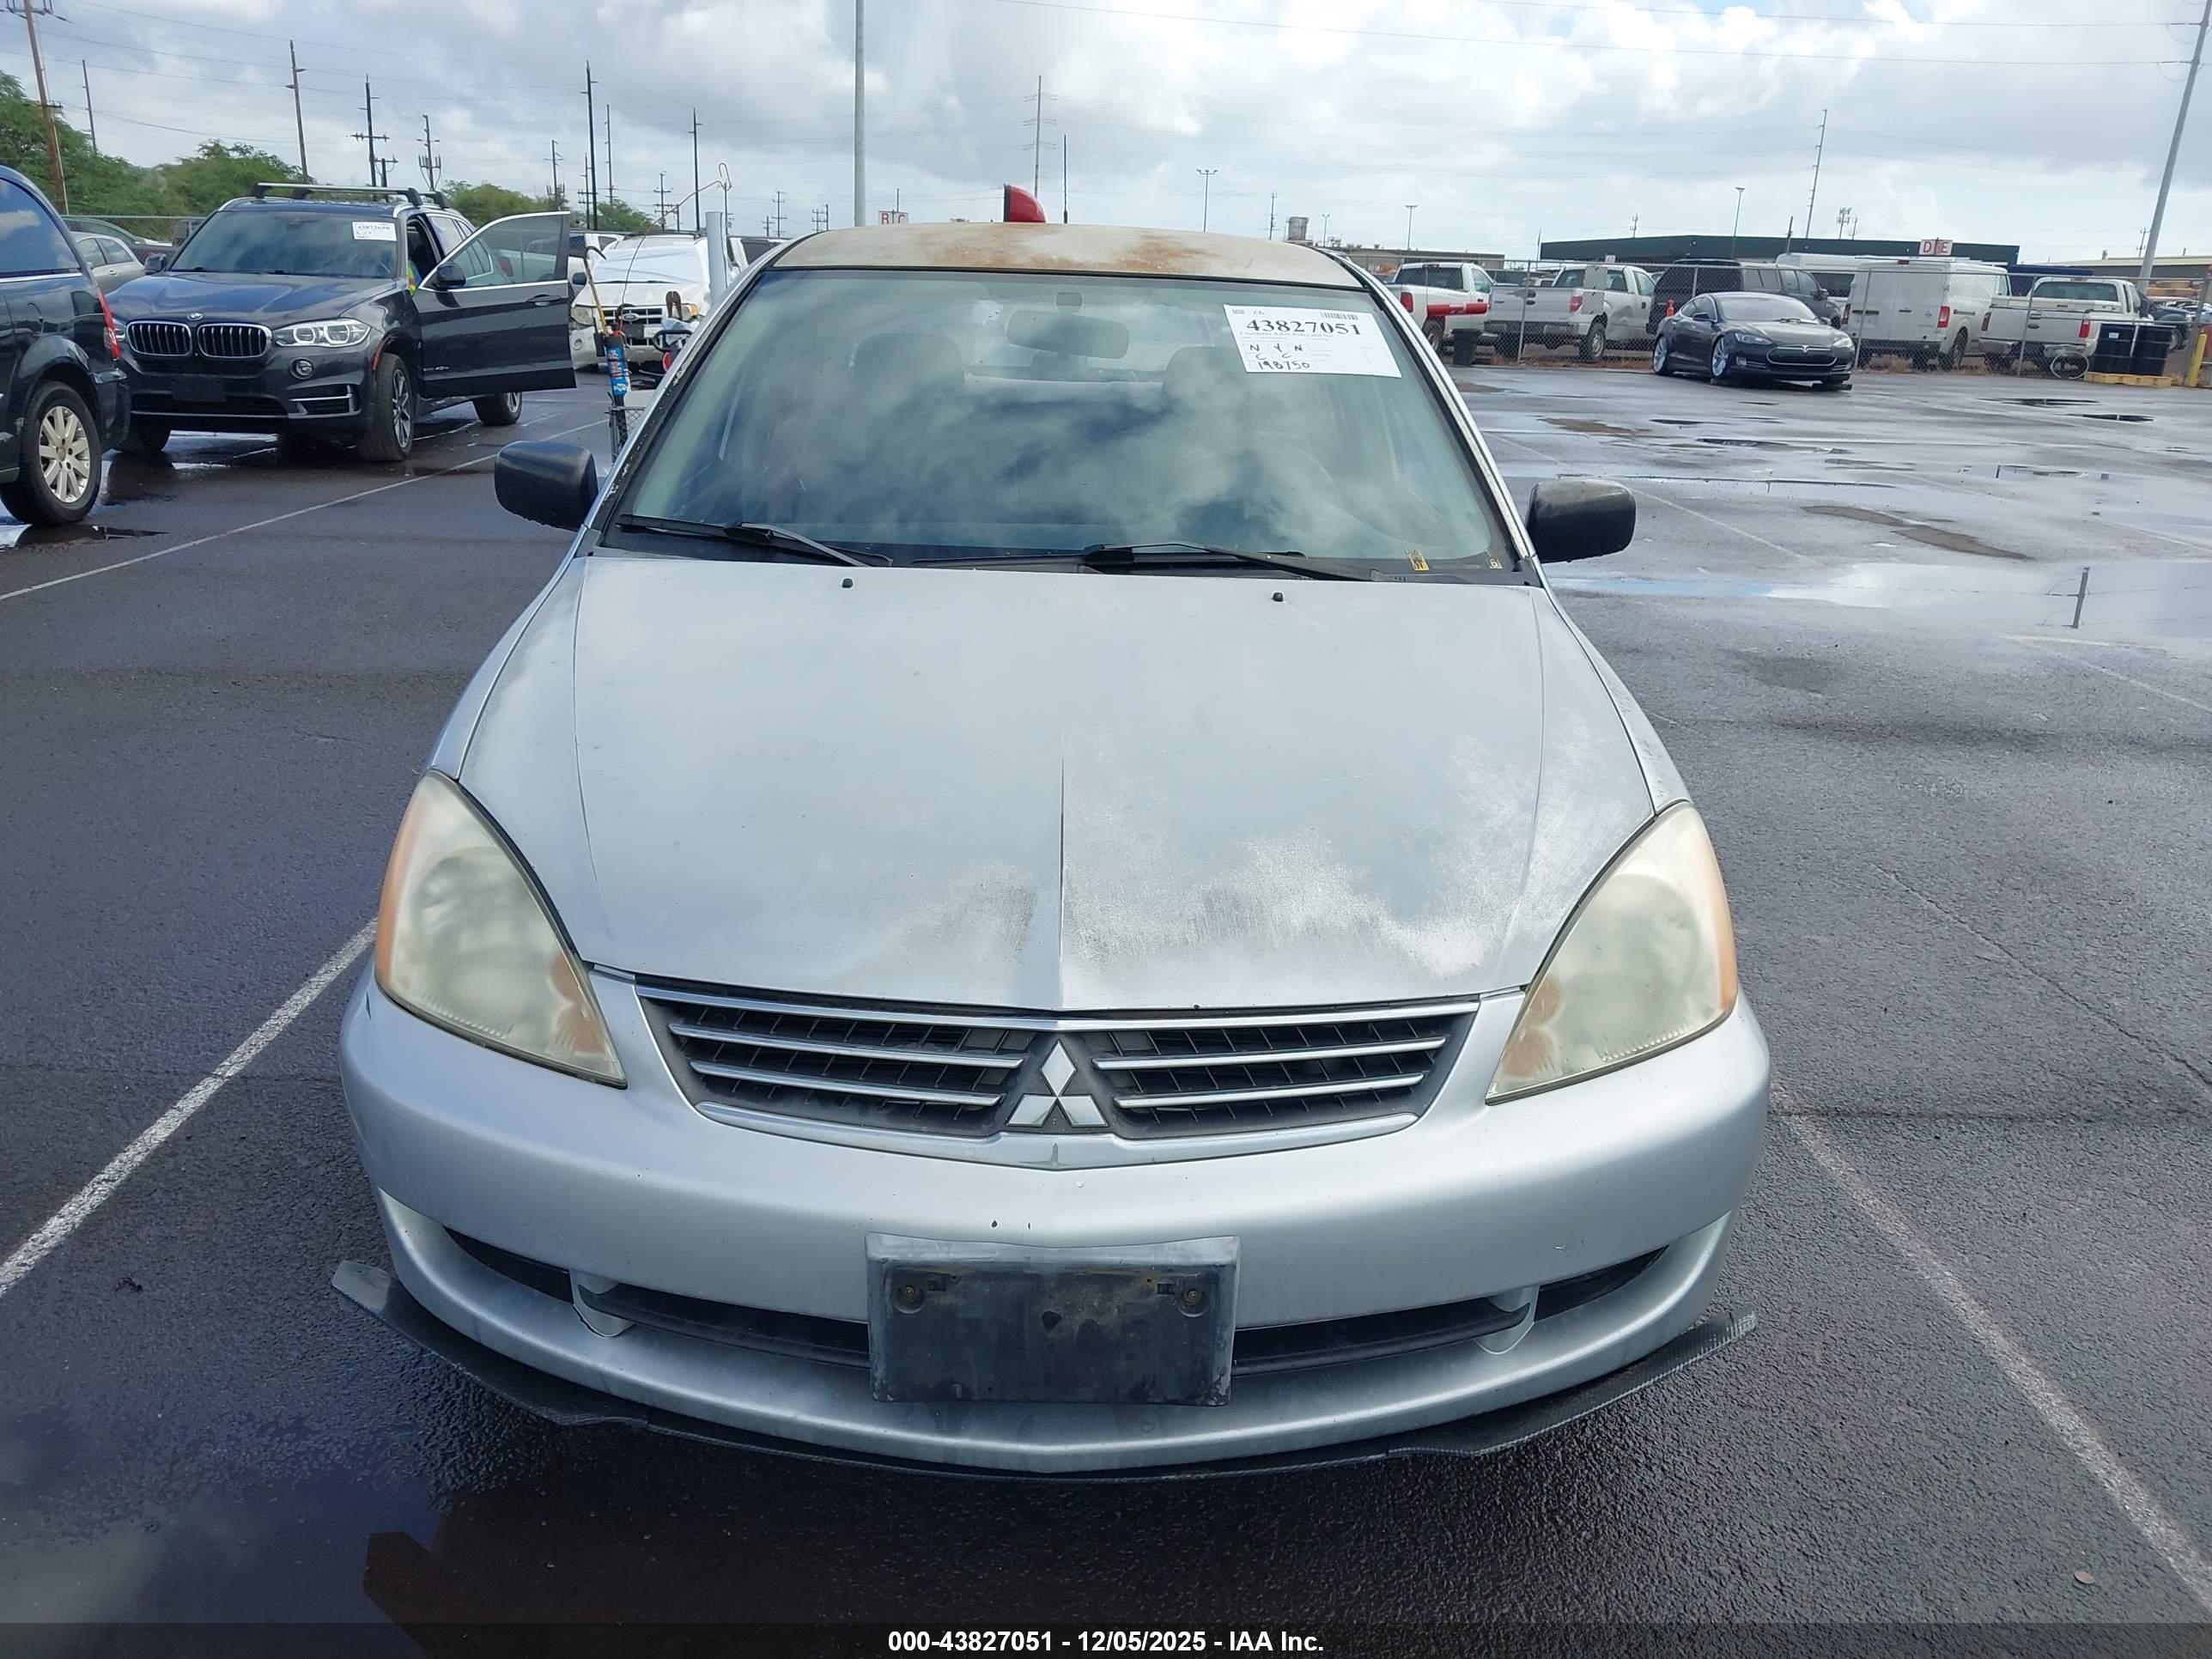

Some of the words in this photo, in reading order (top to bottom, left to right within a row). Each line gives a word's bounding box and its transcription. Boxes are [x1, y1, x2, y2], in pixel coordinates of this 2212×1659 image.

[881, 212, 890, 225] R
[1923, 240, 1932, 253] D
[1941, 241, 1950, 253] E
[1246, 319, 1361, 336] 43827051
[1249, 343, 1260, 352] N
[1273, 343, 1283, 353] Y
[1294, 343, 1304, 352] N
[1257, 360, 1310, 370] 198750
